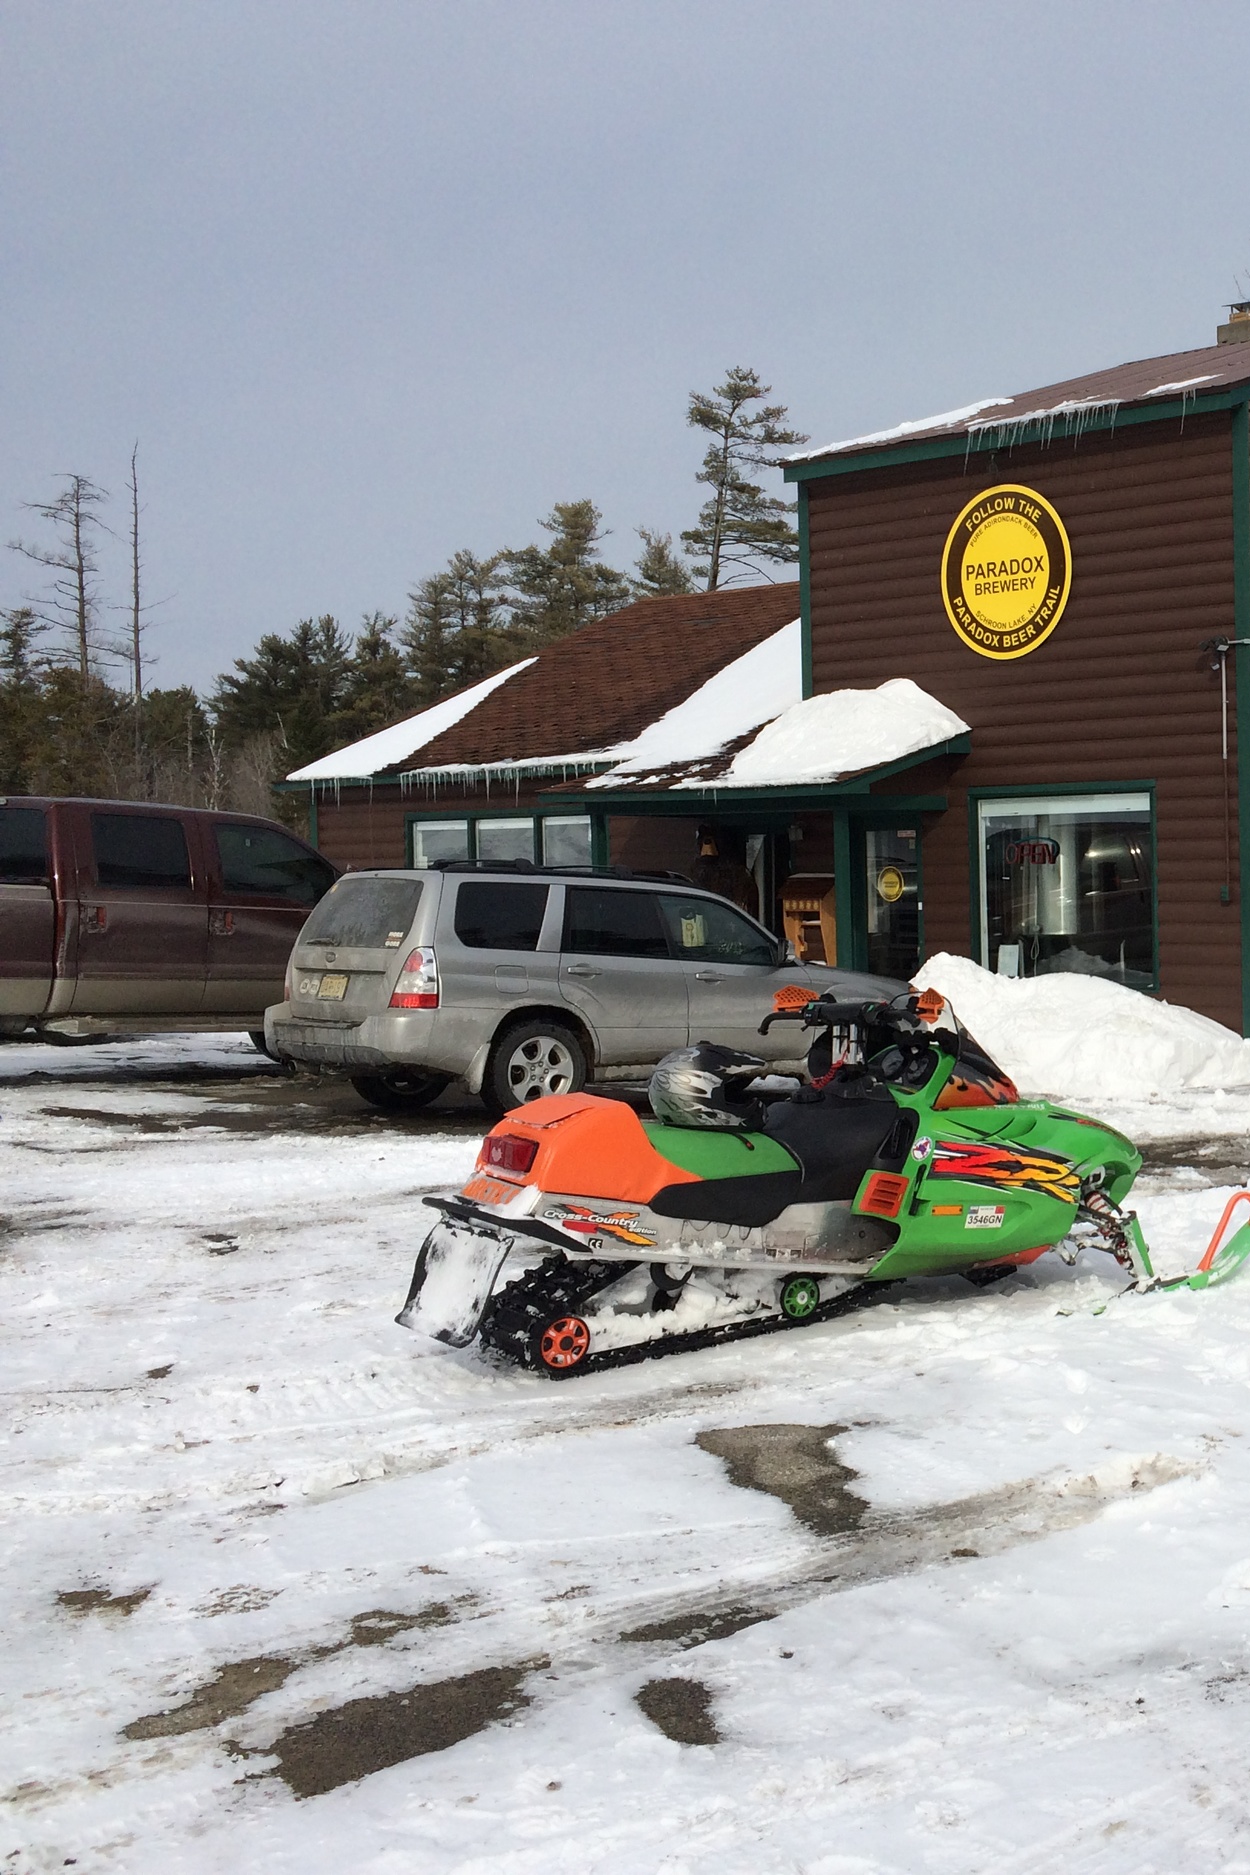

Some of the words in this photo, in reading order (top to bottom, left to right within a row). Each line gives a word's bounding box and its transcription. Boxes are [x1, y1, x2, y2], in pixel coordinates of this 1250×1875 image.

[965, 497, 1015, 532] FOLLOW
[1019, 499, 1042, 523] THE
[970, 529, 984, 548] PURE
[984, 515, 1022, 530] ADIRONDACK
[1023, 522, 1038, 539] BEER
[966, 555, 1044, 581] PARADOX
[974, 576, 1037, 596] BREWERY
[953, 596, 1000, 648] PARADOX
[1003, 624, 1037, 648] BEER
[1034, 585, 1060, 627] TRAIL
[975, 610, 1007, 629] SCHROON
[1028, 603, 1037, 615] NY
[1005, 843, 1057, 865] OPEN
[543, 1209, 639, 1228] Cross-Country
[967, 1214, 1003, 1225] 3546GN
[628, 1227, 657, 1235] edition
